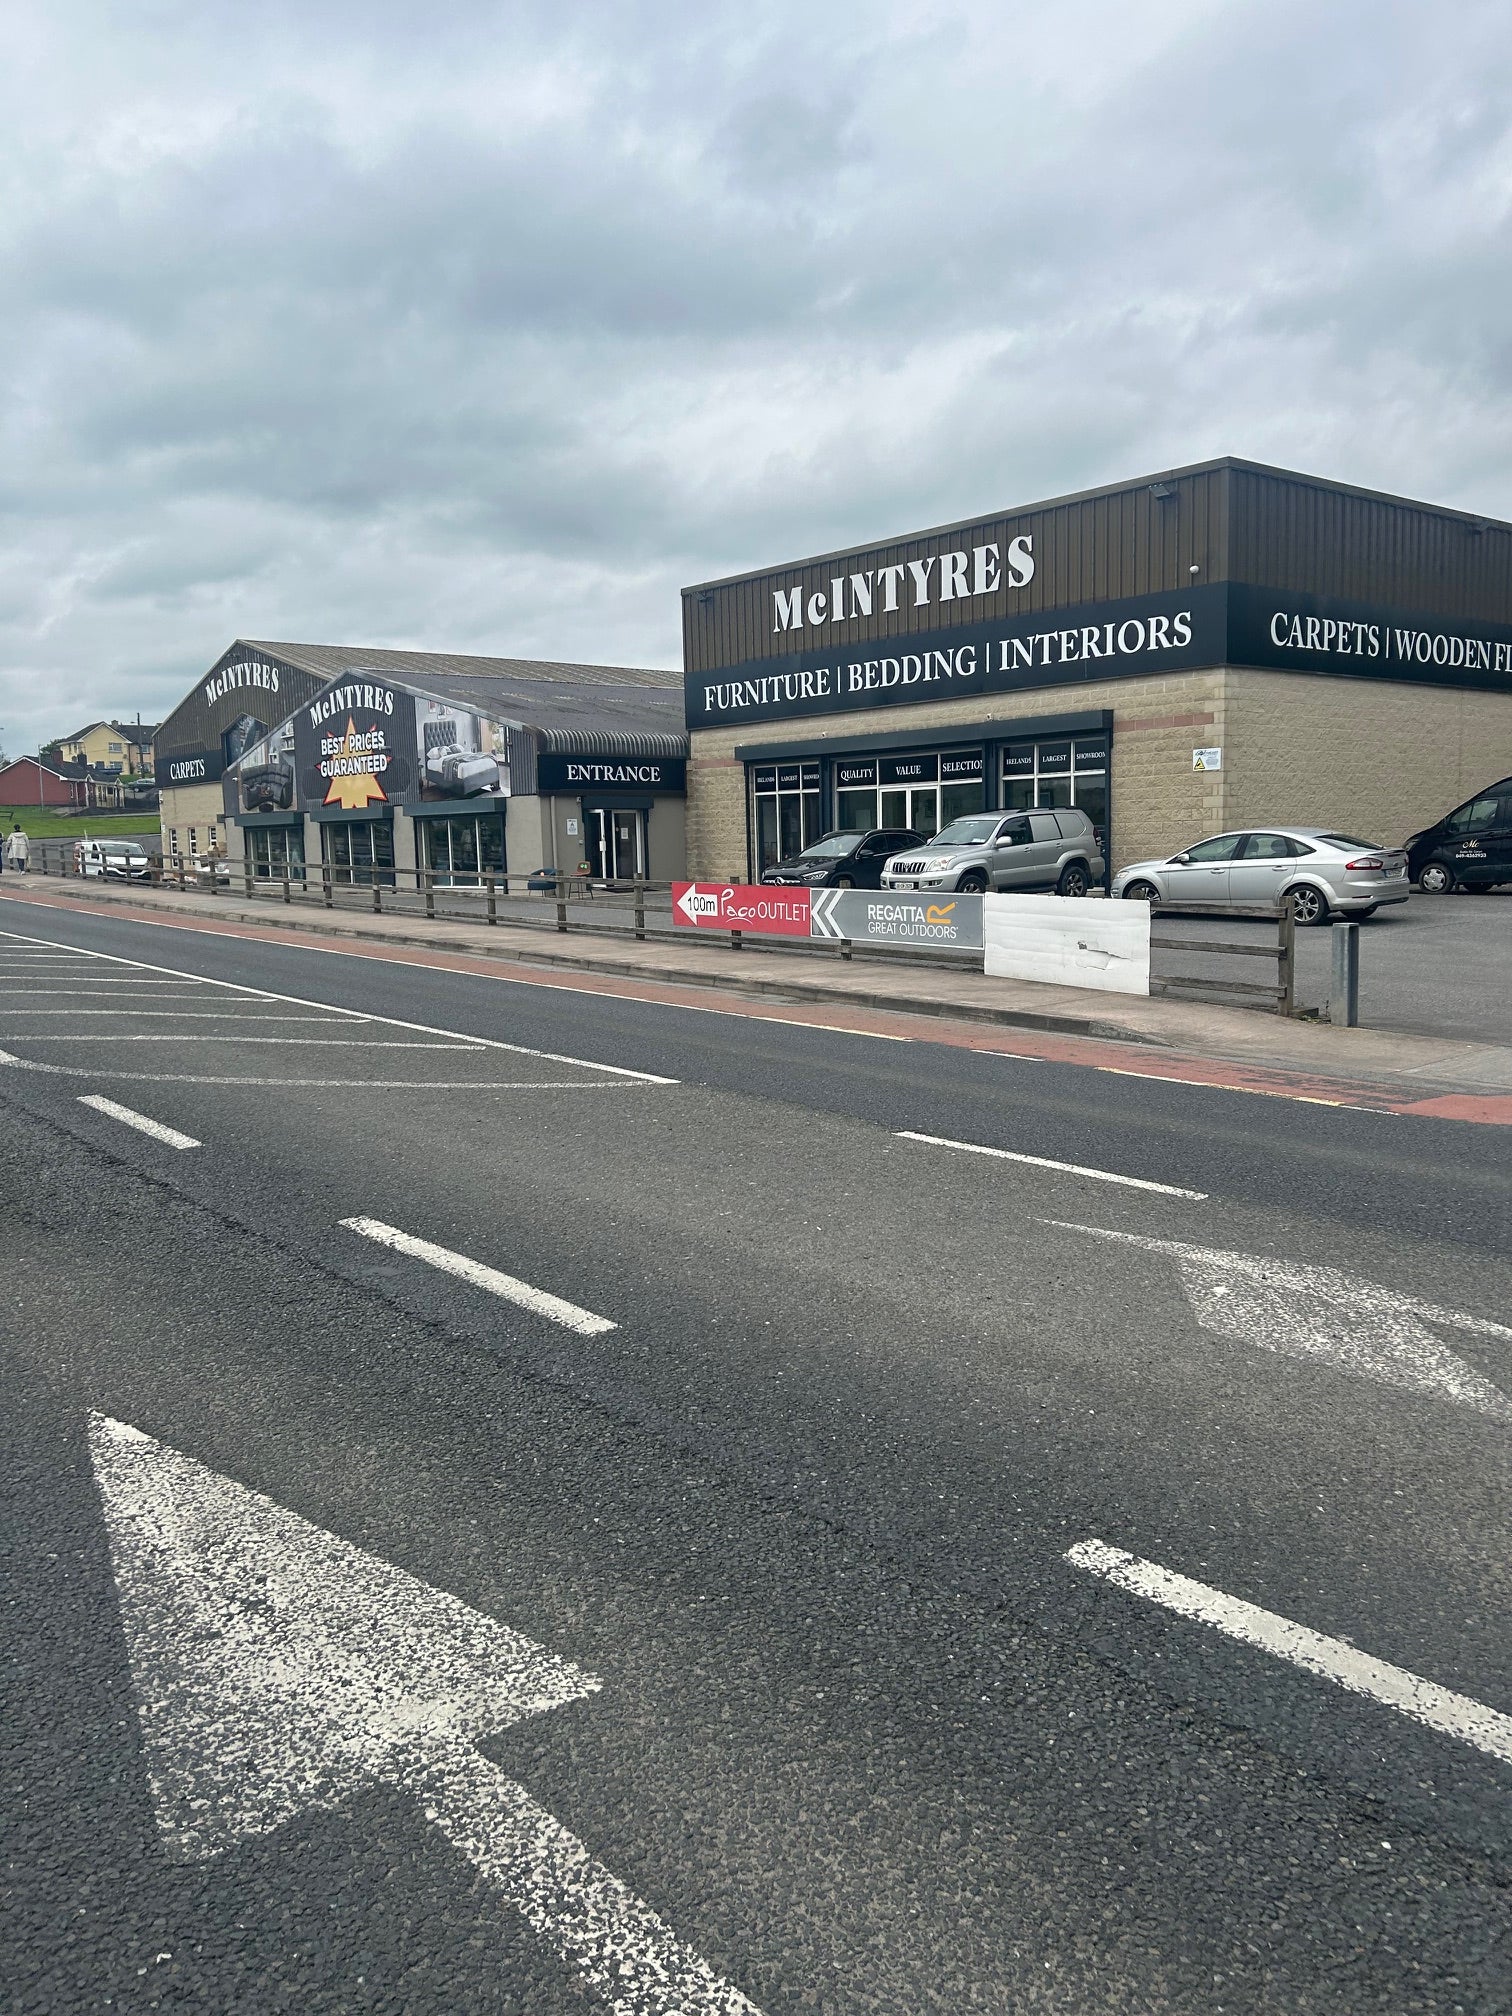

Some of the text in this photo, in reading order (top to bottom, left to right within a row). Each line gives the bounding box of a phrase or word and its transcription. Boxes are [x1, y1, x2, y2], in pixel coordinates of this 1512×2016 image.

[773, 535, 1035, 633] McINTYRES
[1270, 612, 1379, 657] CARPETS
[1394, 629, 1492, 670] WOODEN
[704, 611, 1193, 712] FURNITURE BEDDING INTERIORS
[205, 662, 279, 707] McINTYRES
[309, 684, 394, 729] McINTYRES
[321, 730, 385, 755] BEST PRICES
[170, 759, 205, 780] CARPETS
[320, 754, 387, 777] GUARANTEED
[1006, 757, 1032, 765] IRELANDS
[1042, 754, 1067, 763] LARGEST
[567, 763, 661, 782] ENTRANCE
[840, 768, 873, 781] QUALITY
[896, 765, 921, 775] VALUE
[688, 896, 715, 912] 100m
[757, 901, 808, 921] OUTLET
[867, 904, 926, 922] REGATTA
[868, 921, 957, 939] GREAT OUTDOORS
